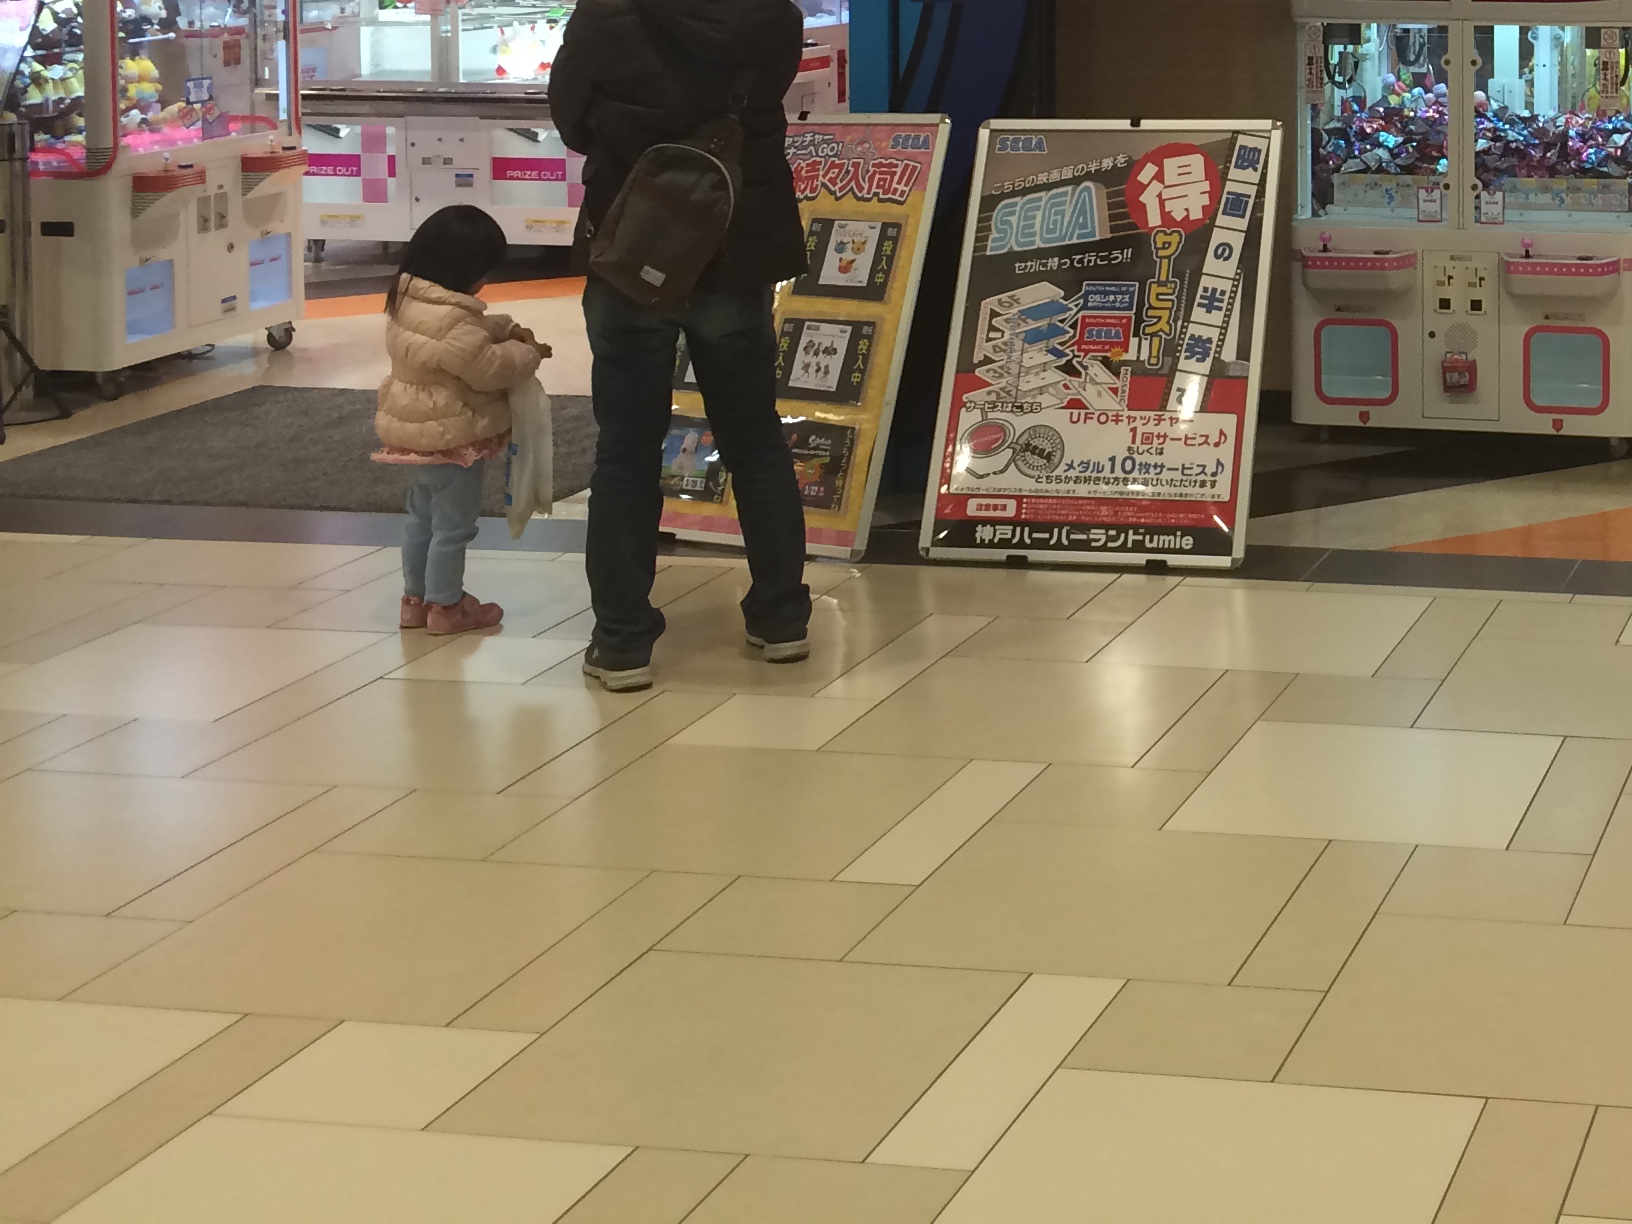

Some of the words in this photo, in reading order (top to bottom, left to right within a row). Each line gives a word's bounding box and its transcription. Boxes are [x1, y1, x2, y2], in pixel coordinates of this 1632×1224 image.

[889, 133, 931, 152] SEGA
[995, 134, 1048, 154] SEGA
[336, 166, 359, 176] OUT
[507, 170, 537, 180] PRIZE
[539, 170, 564, 180] OUT
[991, 153, 1129, 196] こちらの映画館の半券を
[1136, 153, 1211, 228] 得
[986, 180, 1101, 256] SEGA
[874, 239, 895, 287] 投入中
[1014, 248, 1133, 275] セガに持って行こう!!
[1145, 229, 1184, 367] サービス!
[1084, 327, 1124, 342] SEGA
[851, 338, 870, 386] 投入中
[965, 402, 1042, 414] サービスはこちら
[1069, 411, 1195, 426] UFOキャッチャー
[1126, 445, 1165, 456] もしくは
[975, 524, 1194, 550] 神戸ハーバーランドumie
